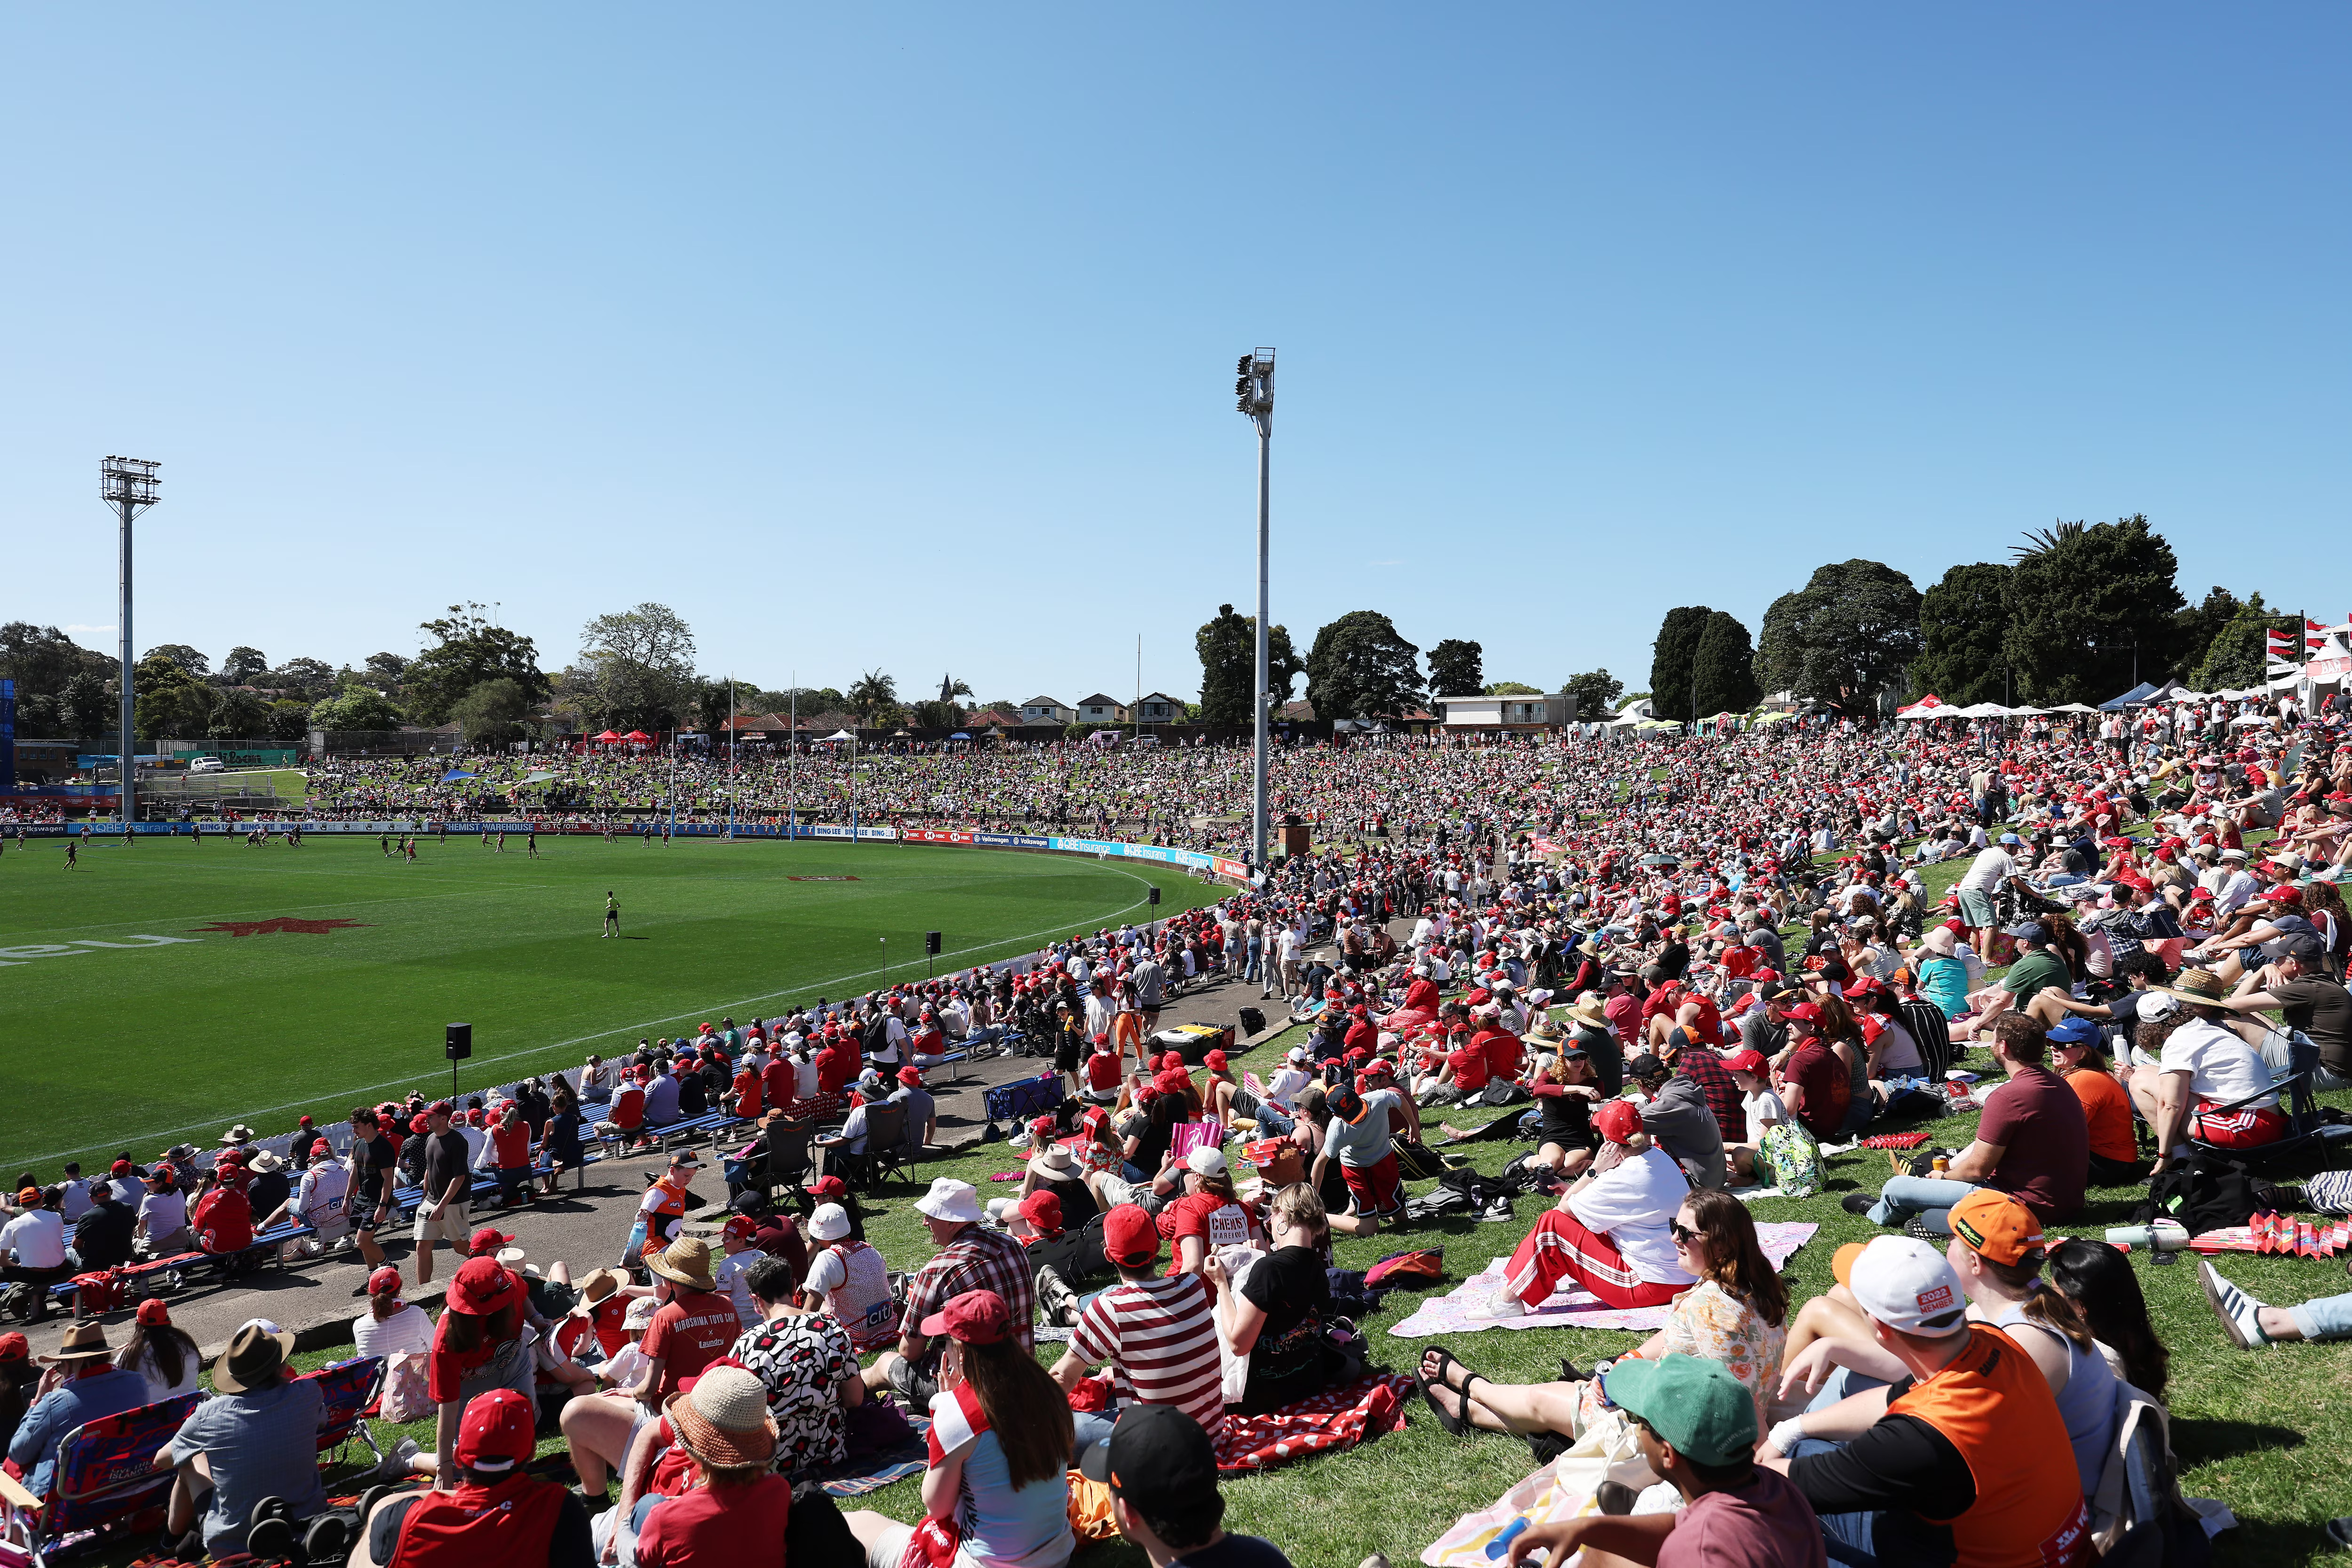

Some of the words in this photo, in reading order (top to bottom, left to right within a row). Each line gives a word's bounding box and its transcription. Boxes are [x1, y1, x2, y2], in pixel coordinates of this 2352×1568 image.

[2322, 660, 2341, 675] BAR
[204, 751, 262, 765] Wilson
[96, 824, 121, 833] QBE
[1064, 839, 1079, 850] QBE
[1079, 840, 1110, 853] Insurance
[1130, 845, 1142, 856] QBE
[1143, 846, 1166, 860] Insurance
[1179, 851, 1189, 864] QBE
[1189, 854, 1208, 868] Insurance
[331, 1198, 345, 1209] cit
[1212, 1217, 1247, 1231] CHEMIST
[1213, 1230, 1247, 1239] WAREHOUS
[1921, 1288, 1947, 1303] 2022
[1919, 1297, 1955, 1314] MEMBER
[869, 1305, 892, 1325] citi
[675, 1315, 707, 1333] HIROSHIMA
[708, 1313, 723, 1324] TOYO
[699, 1338, 723, 1349] Laundry
